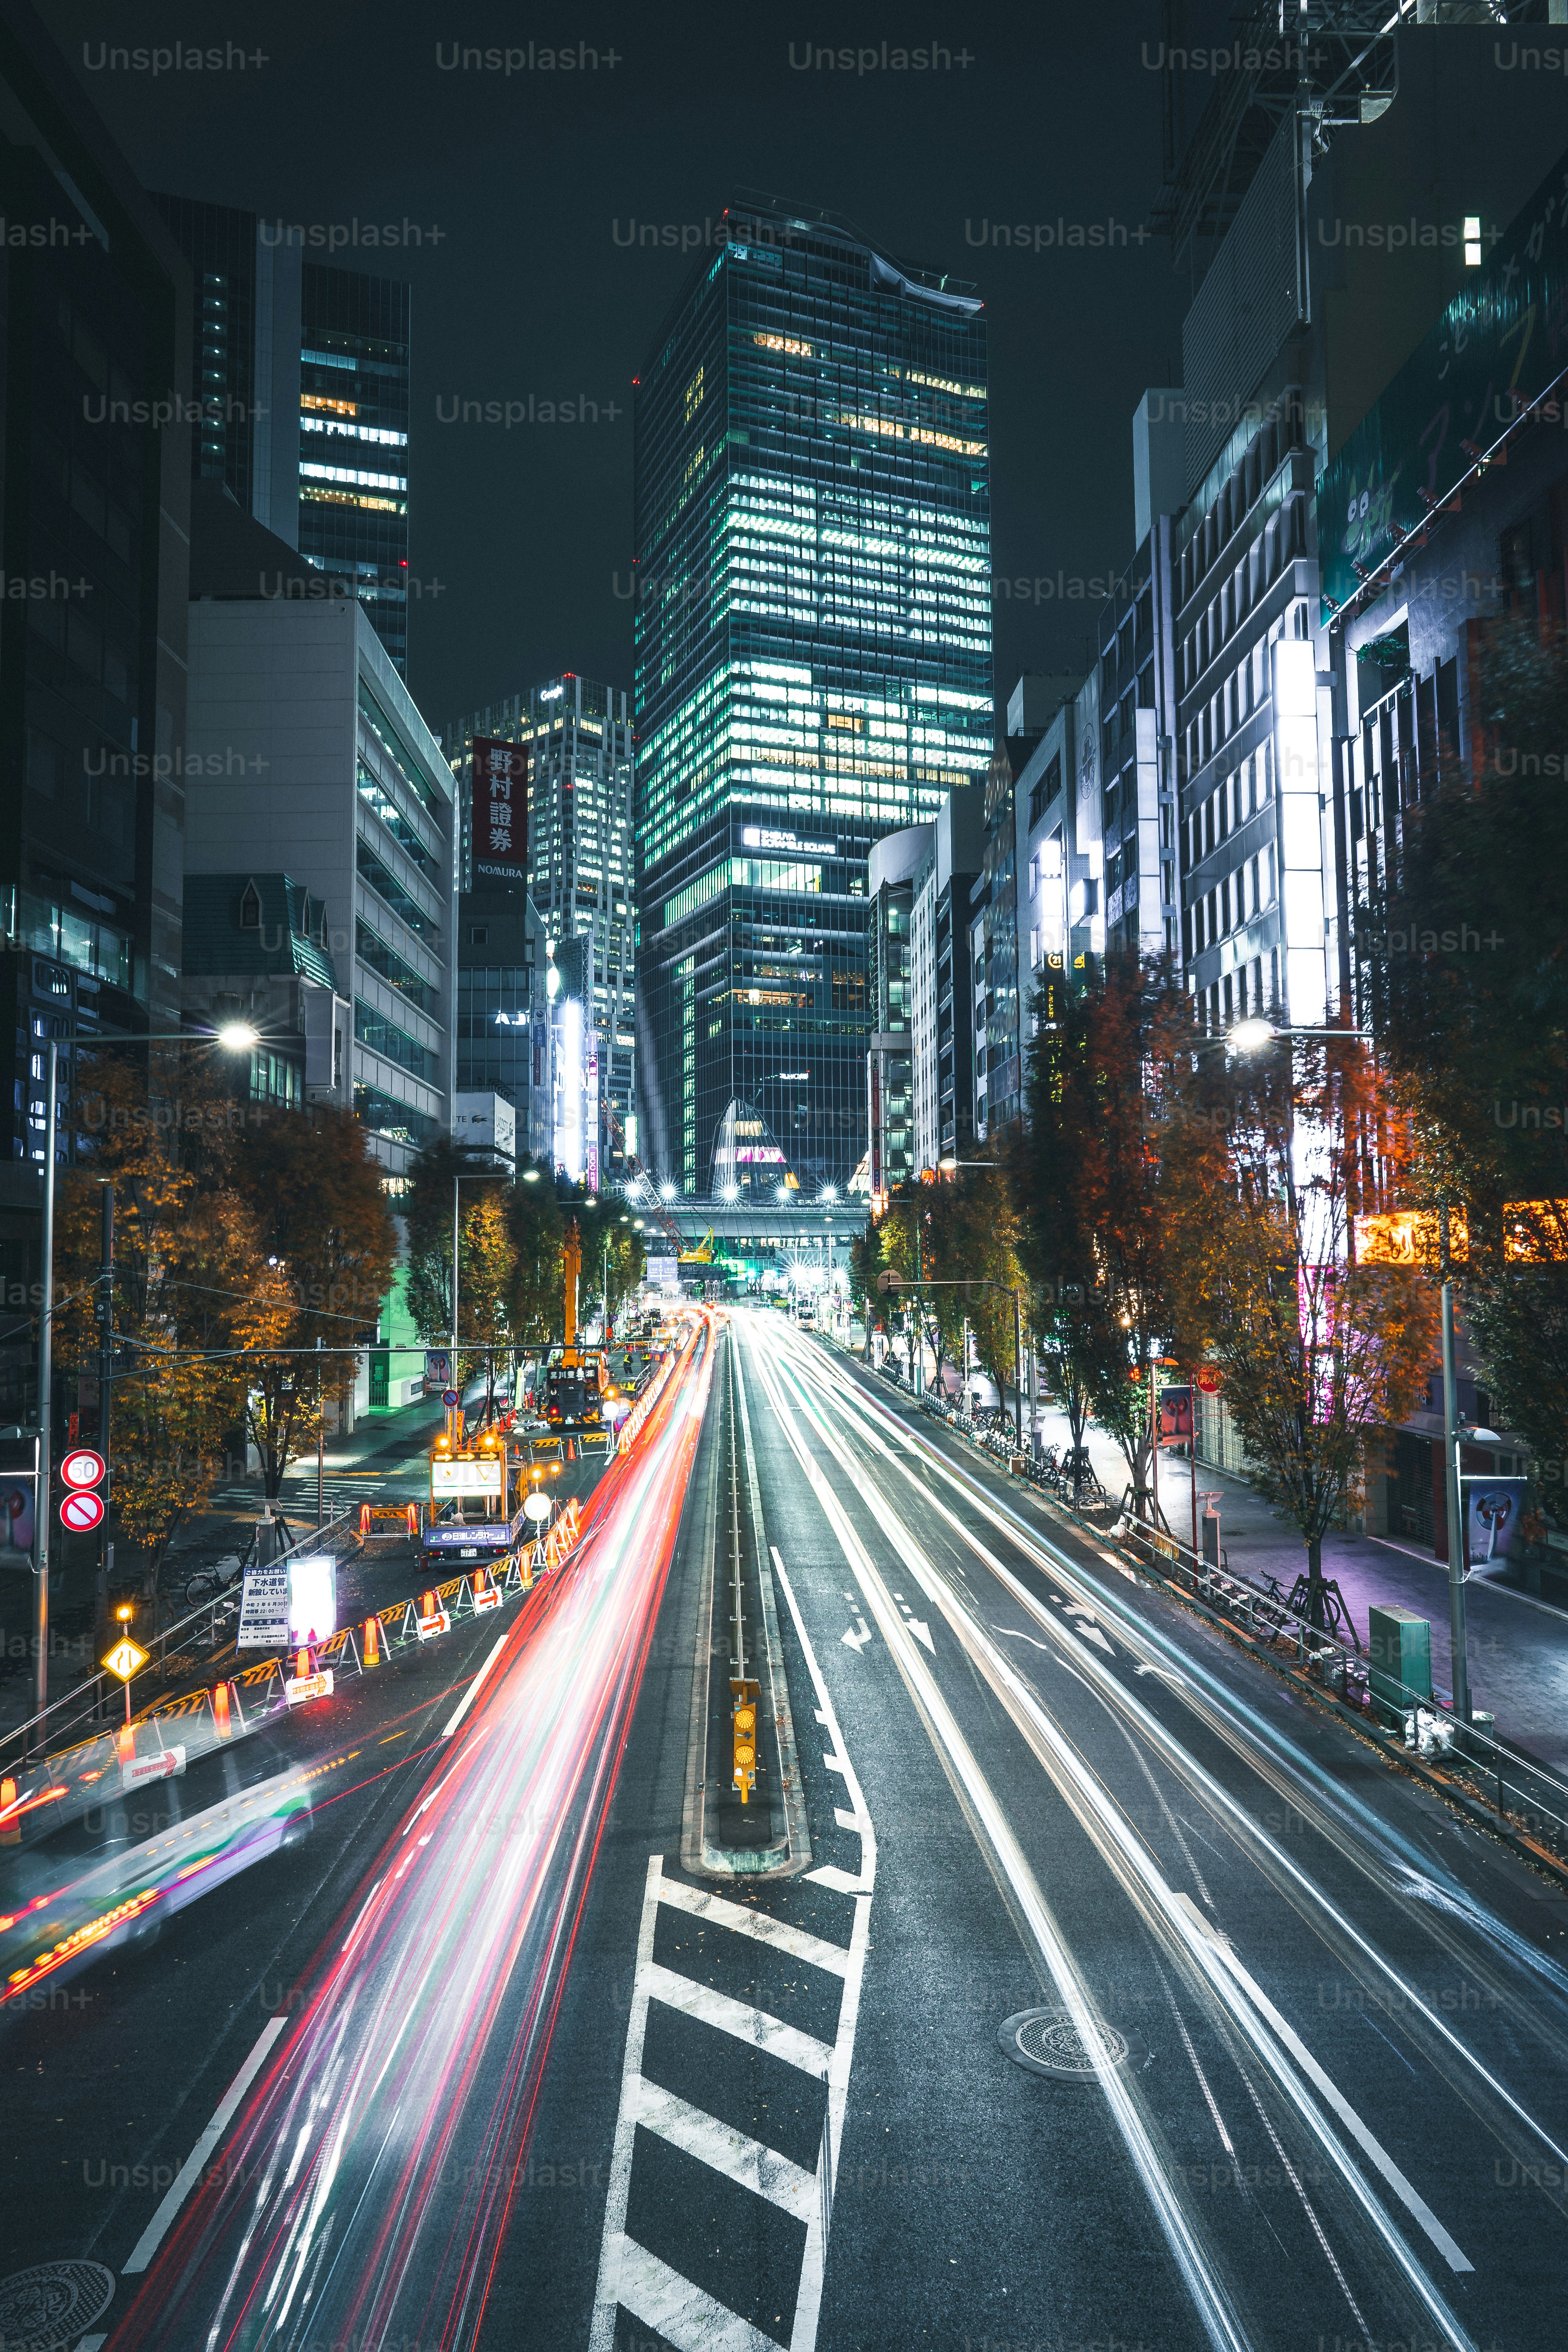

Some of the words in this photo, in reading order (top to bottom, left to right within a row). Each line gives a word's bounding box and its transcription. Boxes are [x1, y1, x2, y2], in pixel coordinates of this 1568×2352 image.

[541, 685, 563, 701] Google
[490, 748, 513, 851] 野村證券
[761, 830, 796, 842] SHIBUYA
[761, 839, 803, 850] SCRAMBLE
[804, 842, 835, 854] SQUARE
[478, 864, 523, 878] NOMURA
[72, 1461, 94, 1478] 50
[452, 1532, 494, 1541] 日進レンタカー
[252, 1577, 285, 1587] 下水道管
[248, 1588, 287, 1596] 新設していま
